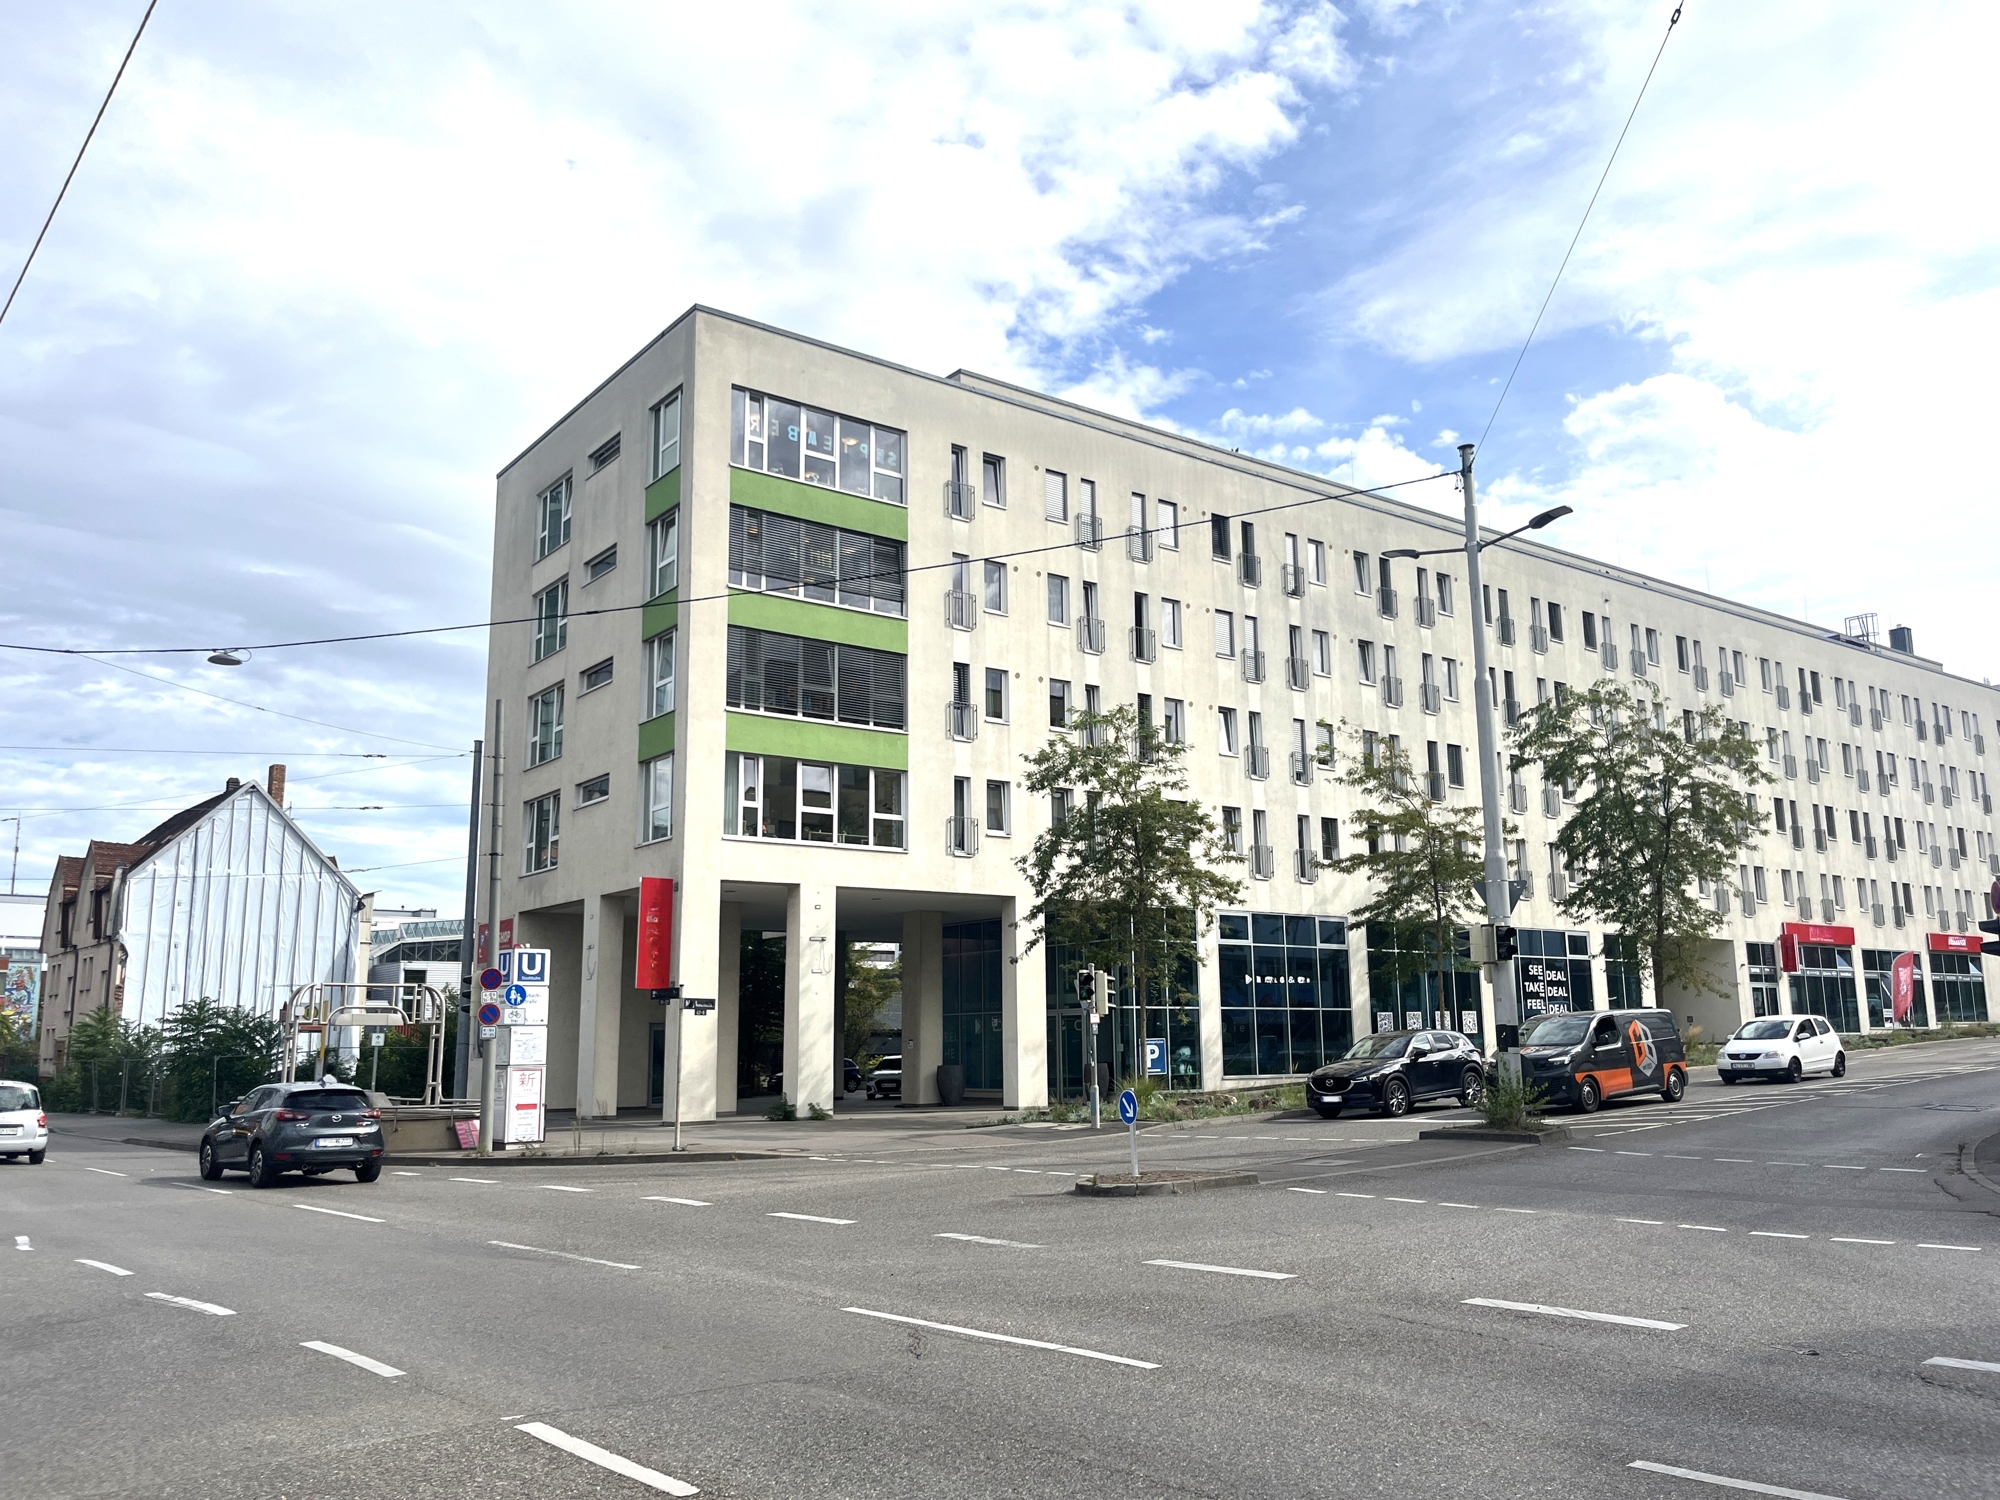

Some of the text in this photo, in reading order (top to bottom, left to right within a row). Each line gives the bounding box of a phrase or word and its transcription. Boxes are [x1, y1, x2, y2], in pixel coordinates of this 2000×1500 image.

[522, 953, 542, 975] U
[1528, 965, 1543, 975] SEE
[1546, 970, 1566, 981] DEAL
[1524, 981, 1545, 992] TAKE
[1547, 986, 1568, 997] DEAL
[1527, 999, 1546, 1010] FEEL
[1549, 1004, 1568, 1014] DEAL
[1146, 1044, 1160, 1068] P
